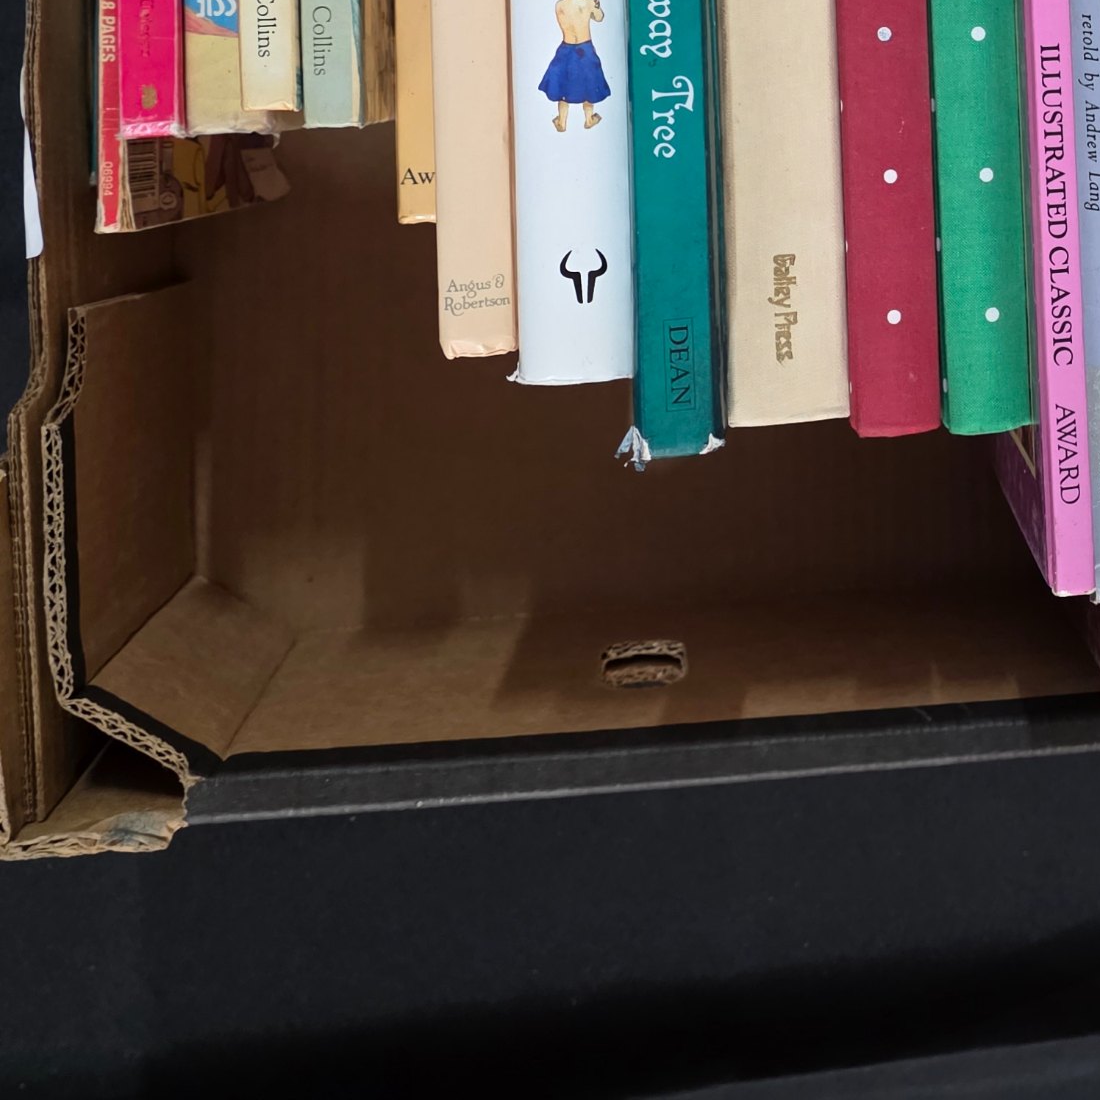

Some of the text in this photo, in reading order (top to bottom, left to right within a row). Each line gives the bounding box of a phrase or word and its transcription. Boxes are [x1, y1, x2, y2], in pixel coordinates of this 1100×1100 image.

[100, 15, 116, 64] PAGES
[312, 5, 333, 76] Collins
[1080, 13, 1099, 63] retold
[651, 75, 695, 158] Tree
[1078, 72, 1100, 92] by
[1039, 43, 1074, 367] ILLUSTRATED CLASSIC
[443, 295, 511, 317] Robertson
[446, 278, 492, 298] Angus
[767, 253, 798, 362] Galley Press
[669, 324, 692, 405] DEAN
[1053, 403, 1081, 506] AWARD
